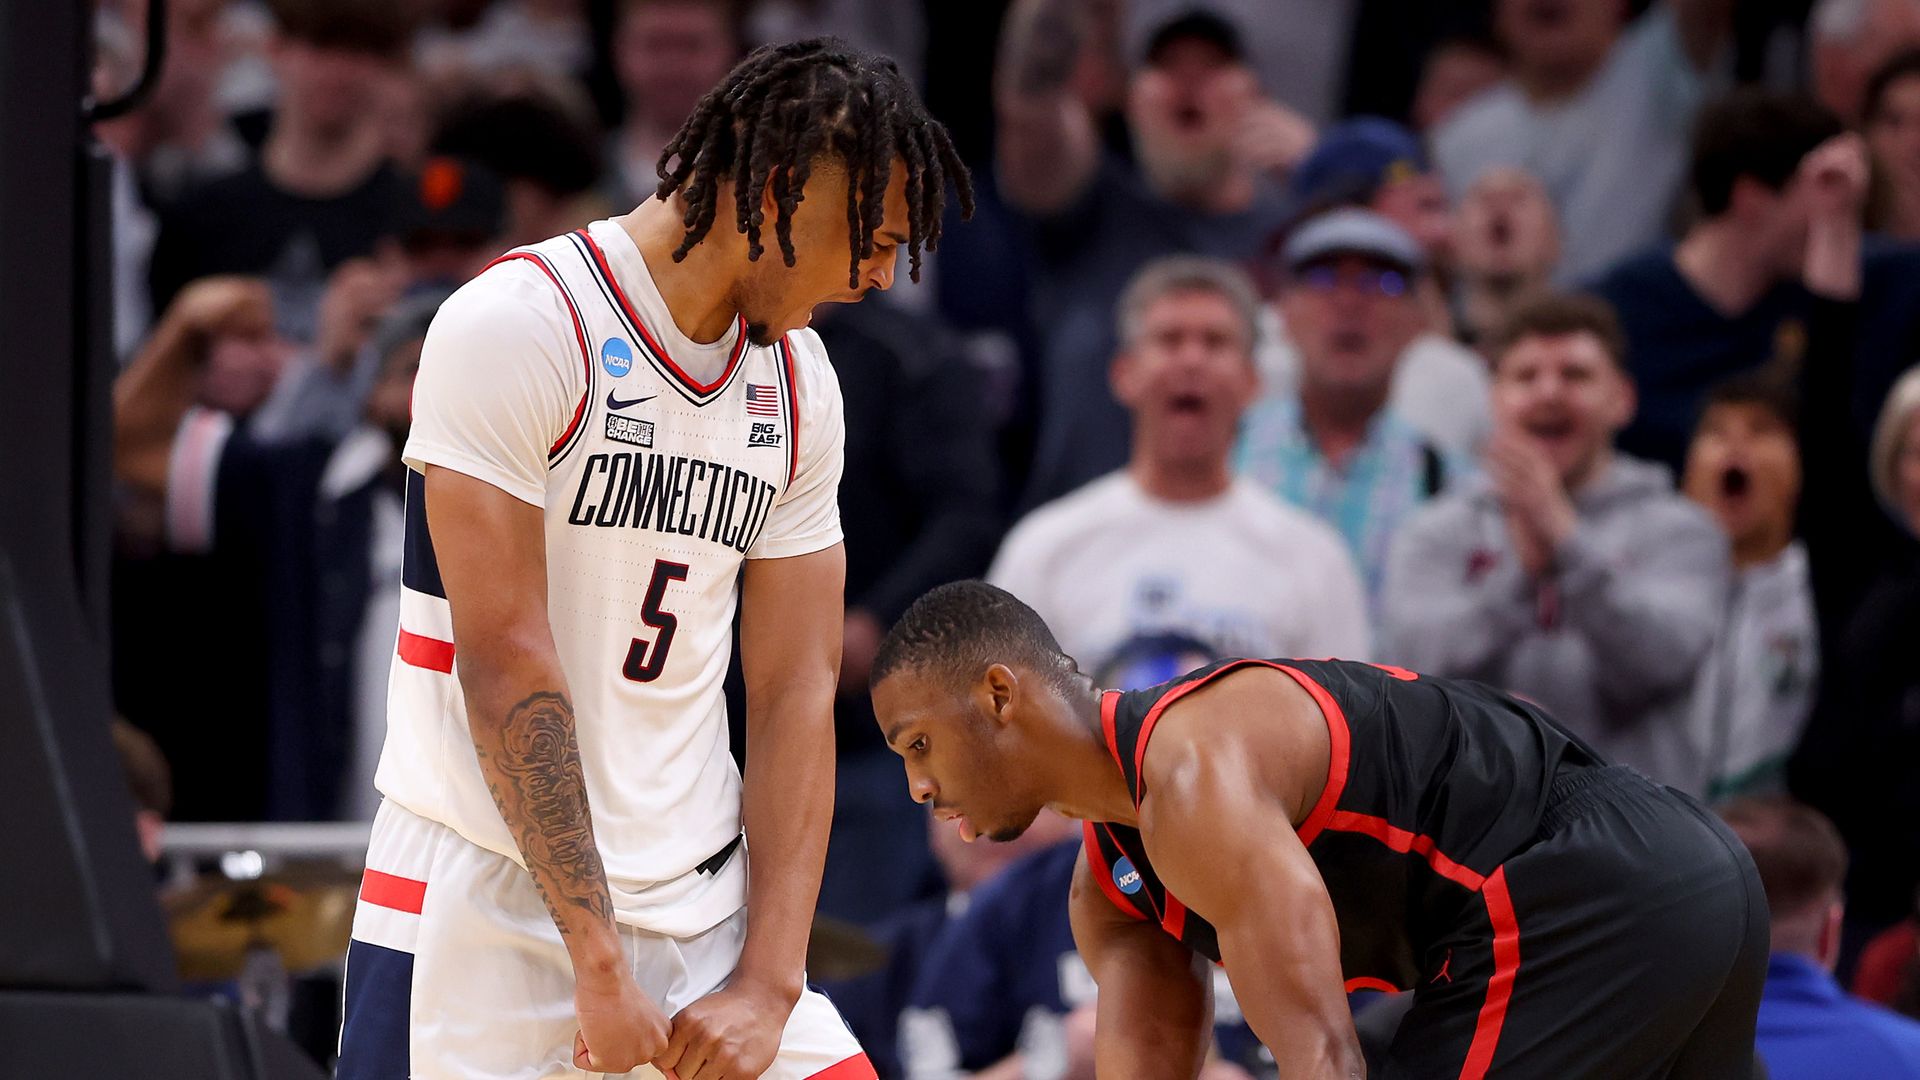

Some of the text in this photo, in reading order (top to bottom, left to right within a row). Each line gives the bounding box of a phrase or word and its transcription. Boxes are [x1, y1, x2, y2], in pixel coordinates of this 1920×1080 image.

[605, 354, 630, 370] NCAA
[751, 422, 776, 434] BIG
[607, 429, 652, 446] CHANGE
[748, 433, 783, 445] EAST
[568, 452, 777, 556] CONNECTICUT
[622, 558, 690, 683] 5
